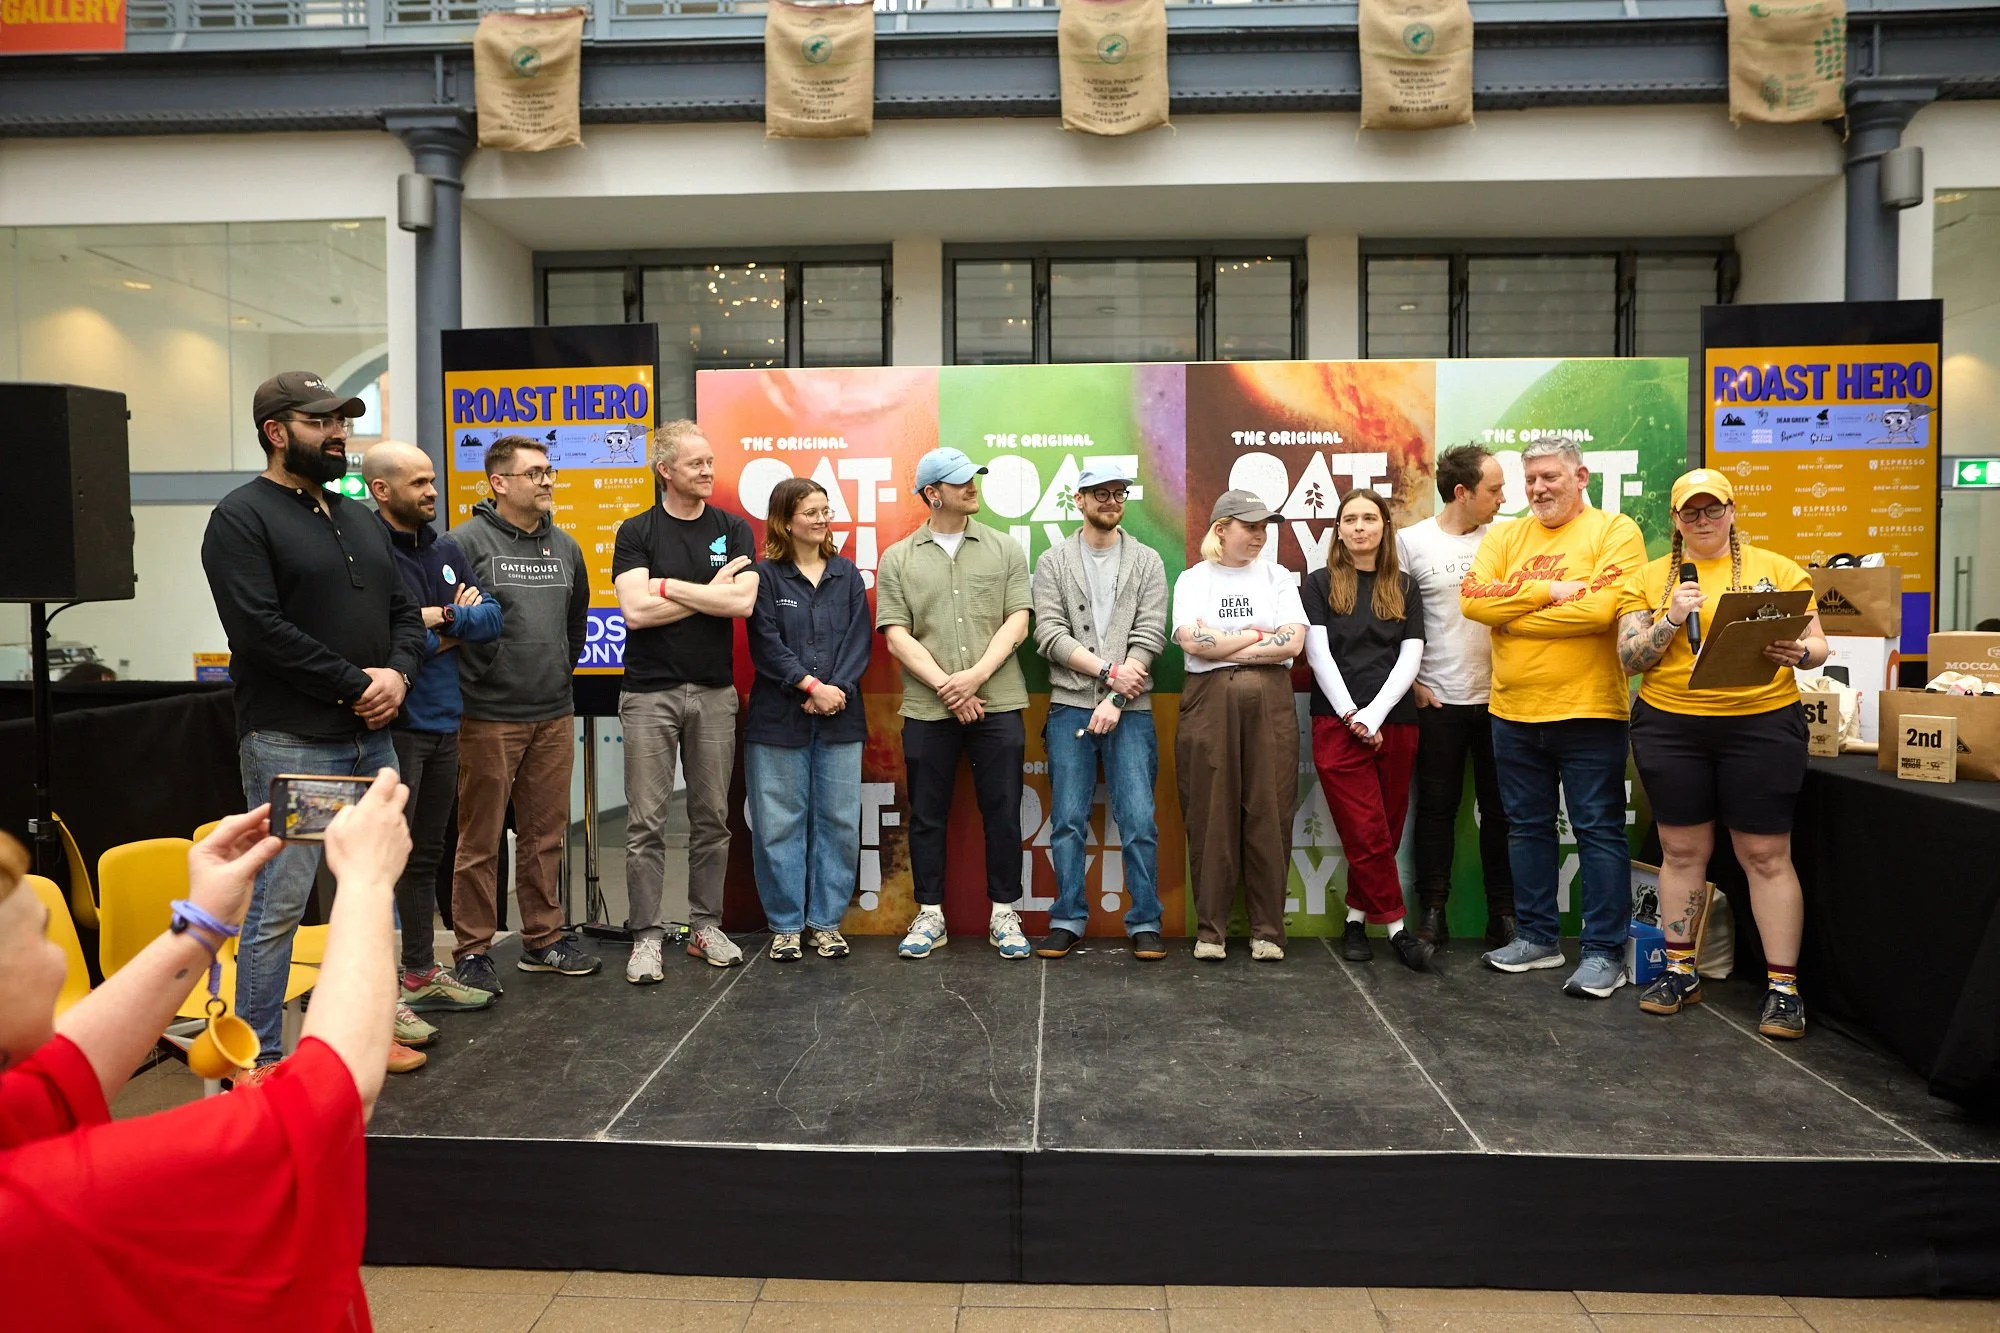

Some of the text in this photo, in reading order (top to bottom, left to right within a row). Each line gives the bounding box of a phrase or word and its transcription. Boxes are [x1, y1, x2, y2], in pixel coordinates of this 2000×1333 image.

[1, 0, 120, 24] GALLERY
[1714, 361, 1932, 402] ROAST HERO
[453, 383, 648, 423] ROAST HERO
[740, 437, 848, 450] THE ORIGINAL
[984, 434, 1094, 448] THE ORIGINAL
[1231, 431, 1343, 445] THE ORIGINAL
[1481, 428, 1516, 444] THE
[501, 563, 559, 573] GATEHOUSE
[1221, 597, 1250, 608] DEAR
[1218, 607, 1254, 618] GREEN
[1803, 700, 1828, 725] st
[1906, 727, 1943, 749] 2nd
